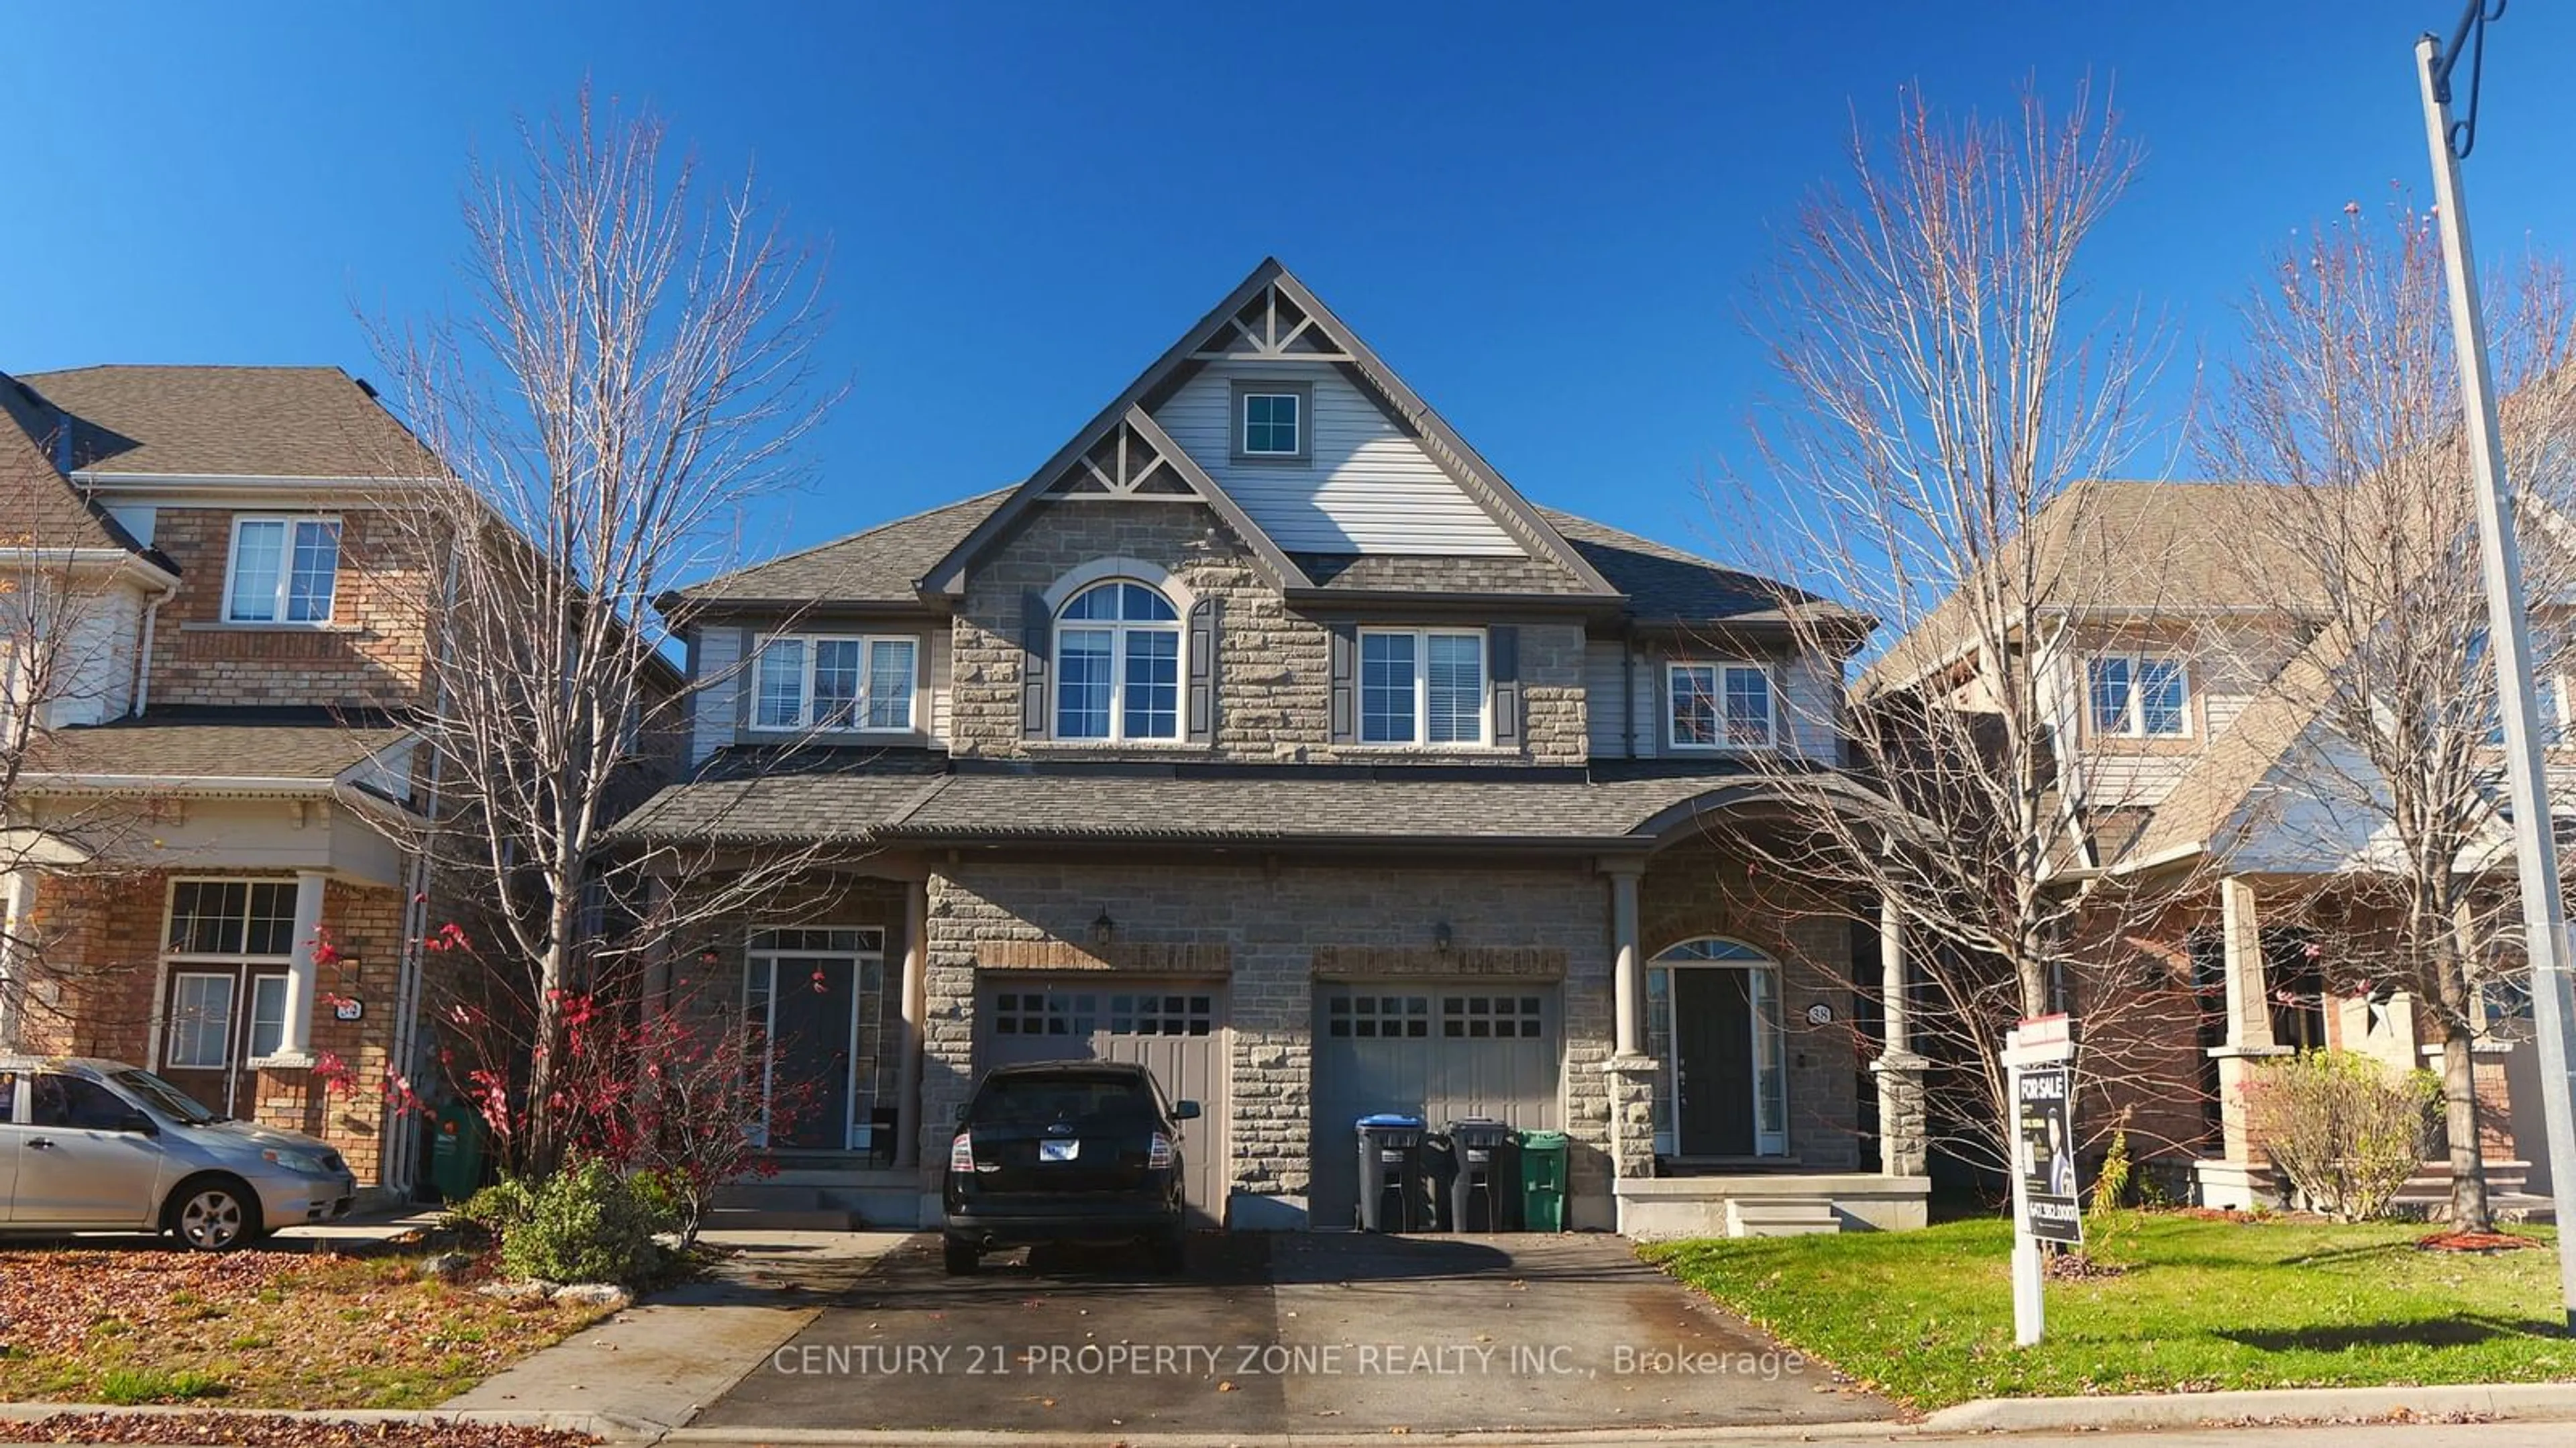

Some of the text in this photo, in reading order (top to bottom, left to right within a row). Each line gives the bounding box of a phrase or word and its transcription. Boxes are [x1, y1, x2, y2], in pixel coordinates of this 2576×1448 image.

[1813, 1009, 1828, 1021] 38
[2021, 1076, 2064, 1100] FOR SALE
